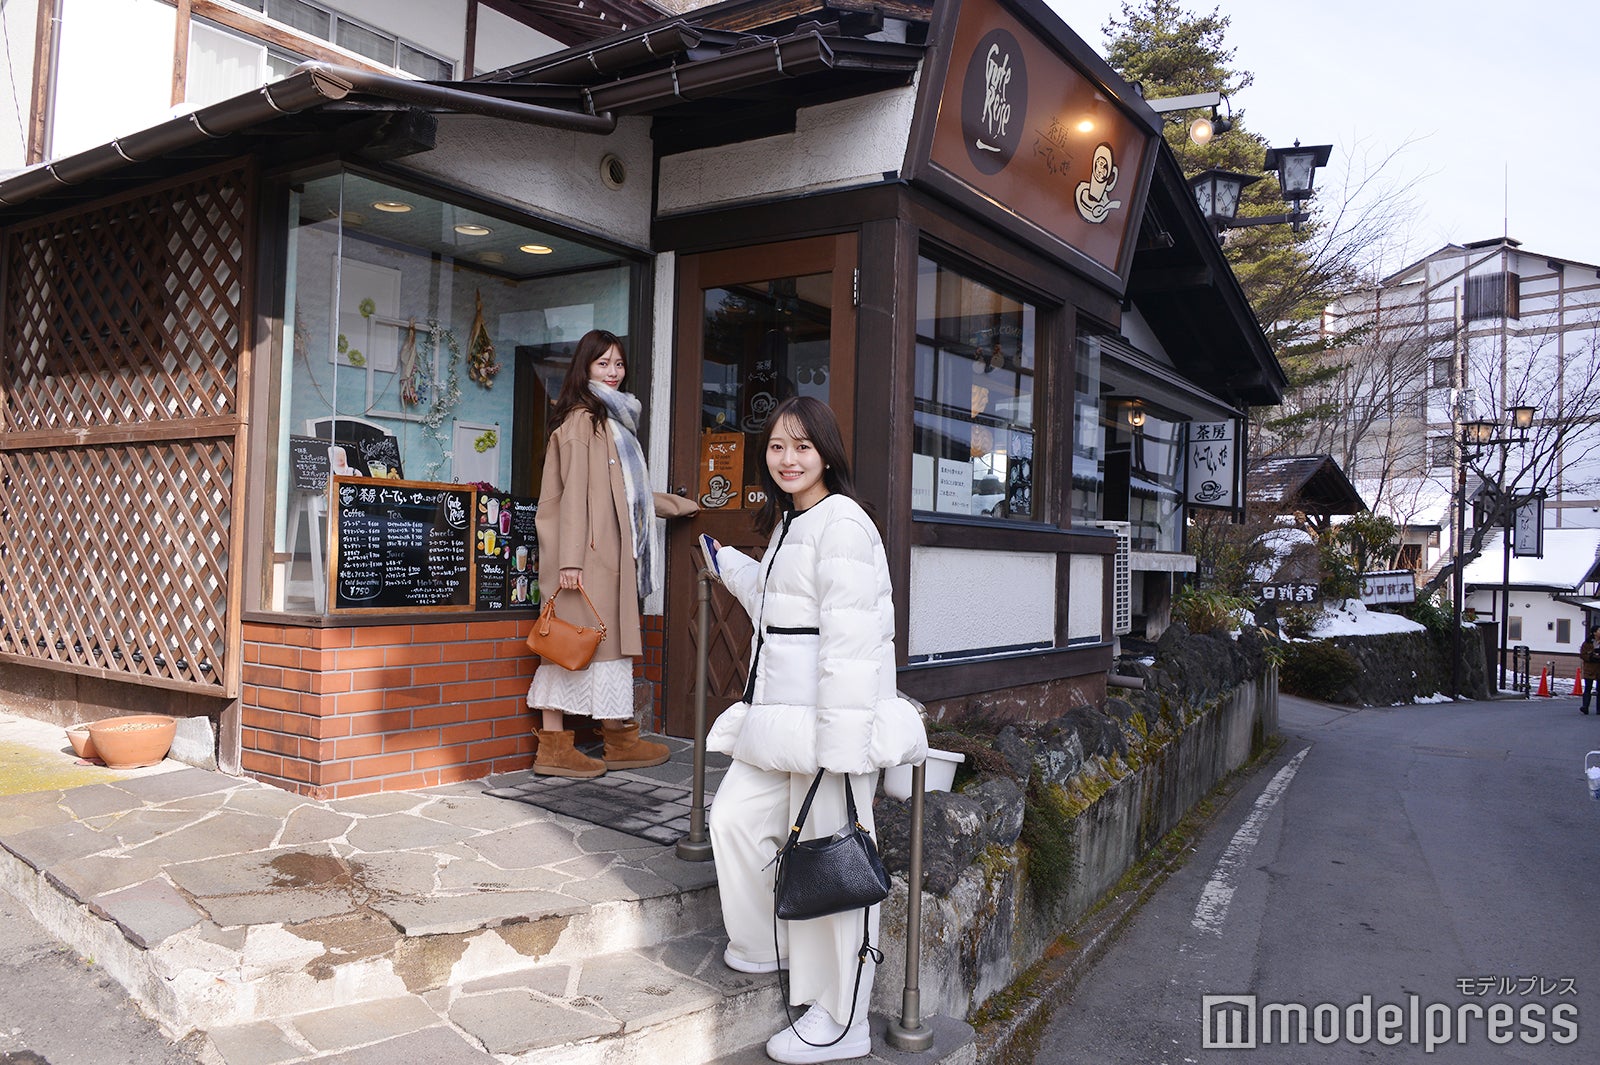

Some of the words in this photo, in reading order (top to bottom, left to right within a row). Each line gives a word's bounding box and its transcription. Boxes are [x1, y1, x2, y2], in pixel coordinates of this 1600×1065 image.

[1047, 116, 1069, 147] 茶房
[1196, 424, 1226, 439] 茶房
[359, 488, 376, 503] 茶房
[748, 492, 768, 503] OP
[342, 508, 365, 518] Coffee
[386, 510, 403, 519] Tea
[429, 528, 454, 537] Sweets
[350, 586, 370, 596] ¥750
